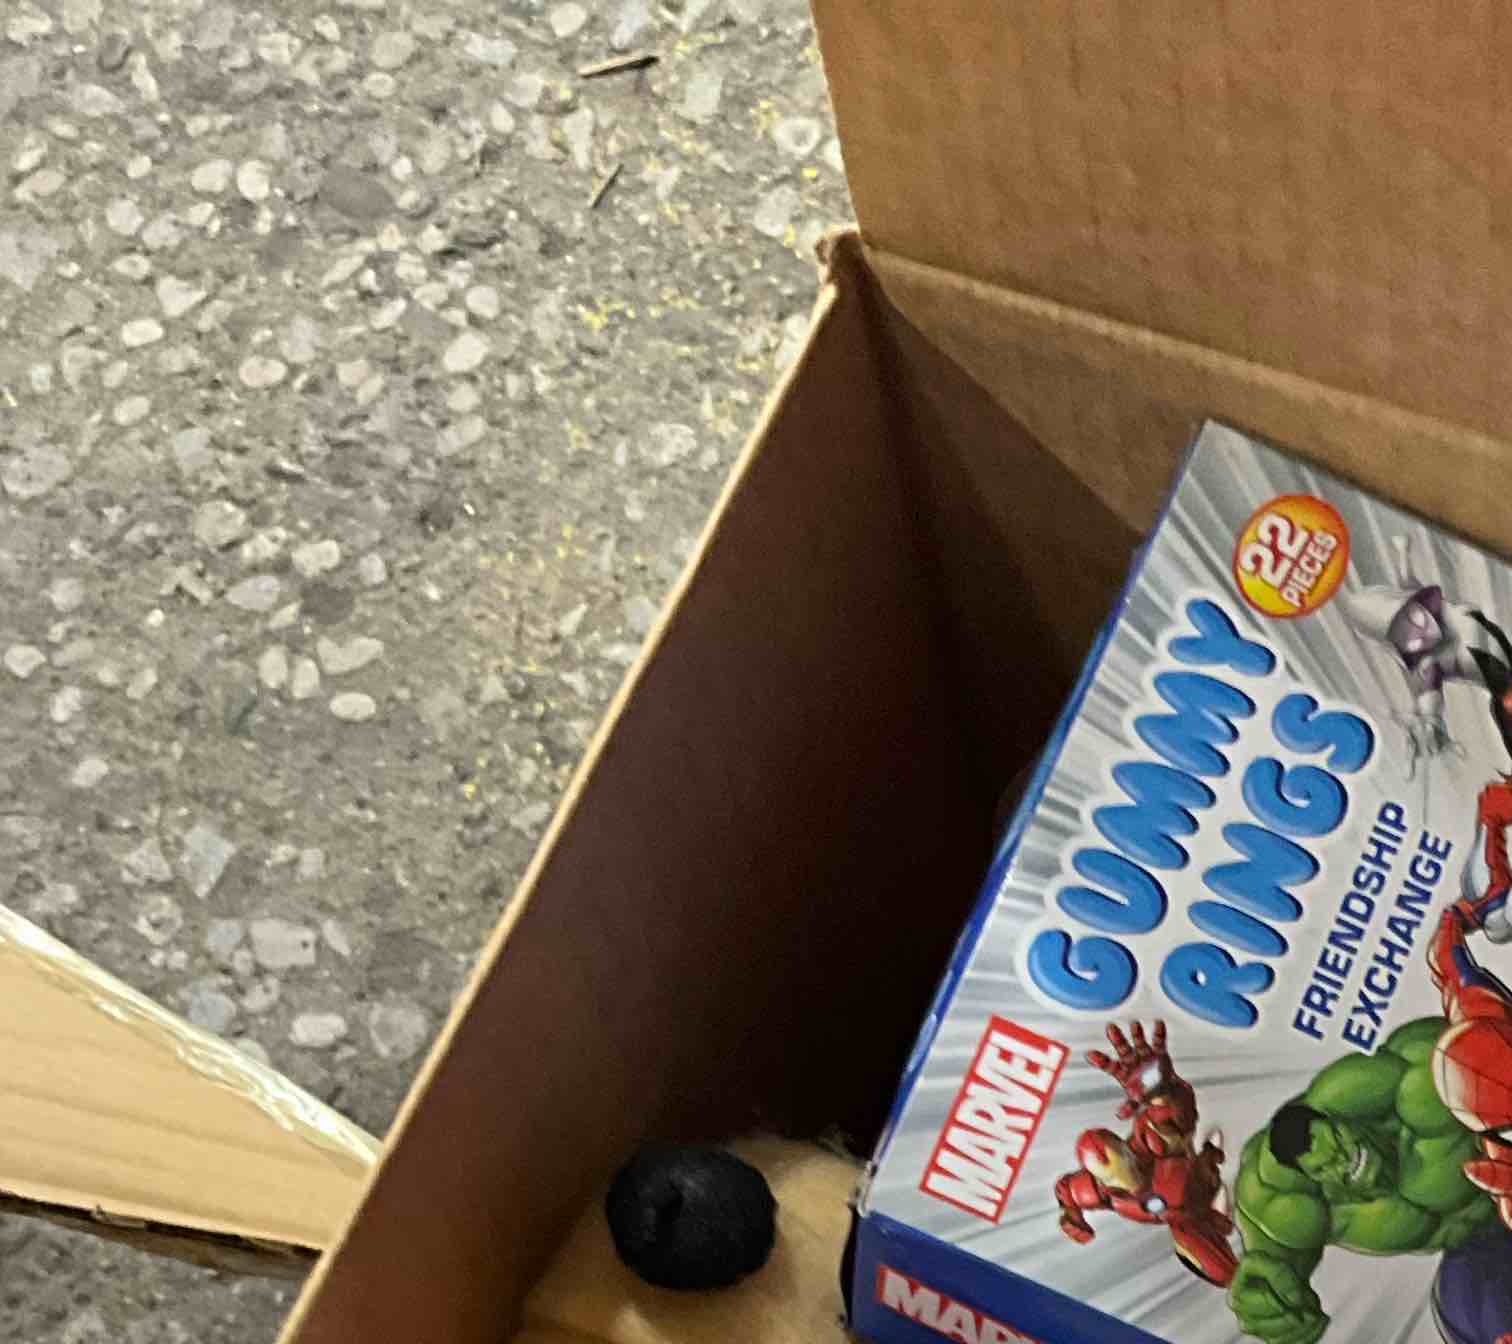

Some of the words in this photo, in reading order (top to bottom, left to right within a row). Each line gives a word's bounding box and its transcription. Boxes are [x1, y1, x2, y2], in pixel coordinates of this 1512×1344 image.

[1240, 513, 1309, 588] 22
[1281, 532, 1337, 607] PIECES
[1028, 598, 1277, 1011] GUMMY
[1160, 692, 1374, 1029] RINGS
[1293, 801, 1407, 1041] FRIENDSHIP
[1342, 832, 1452, 1052] EXCHANGE
[926, 1029, 1064, 1217] MARVEL
